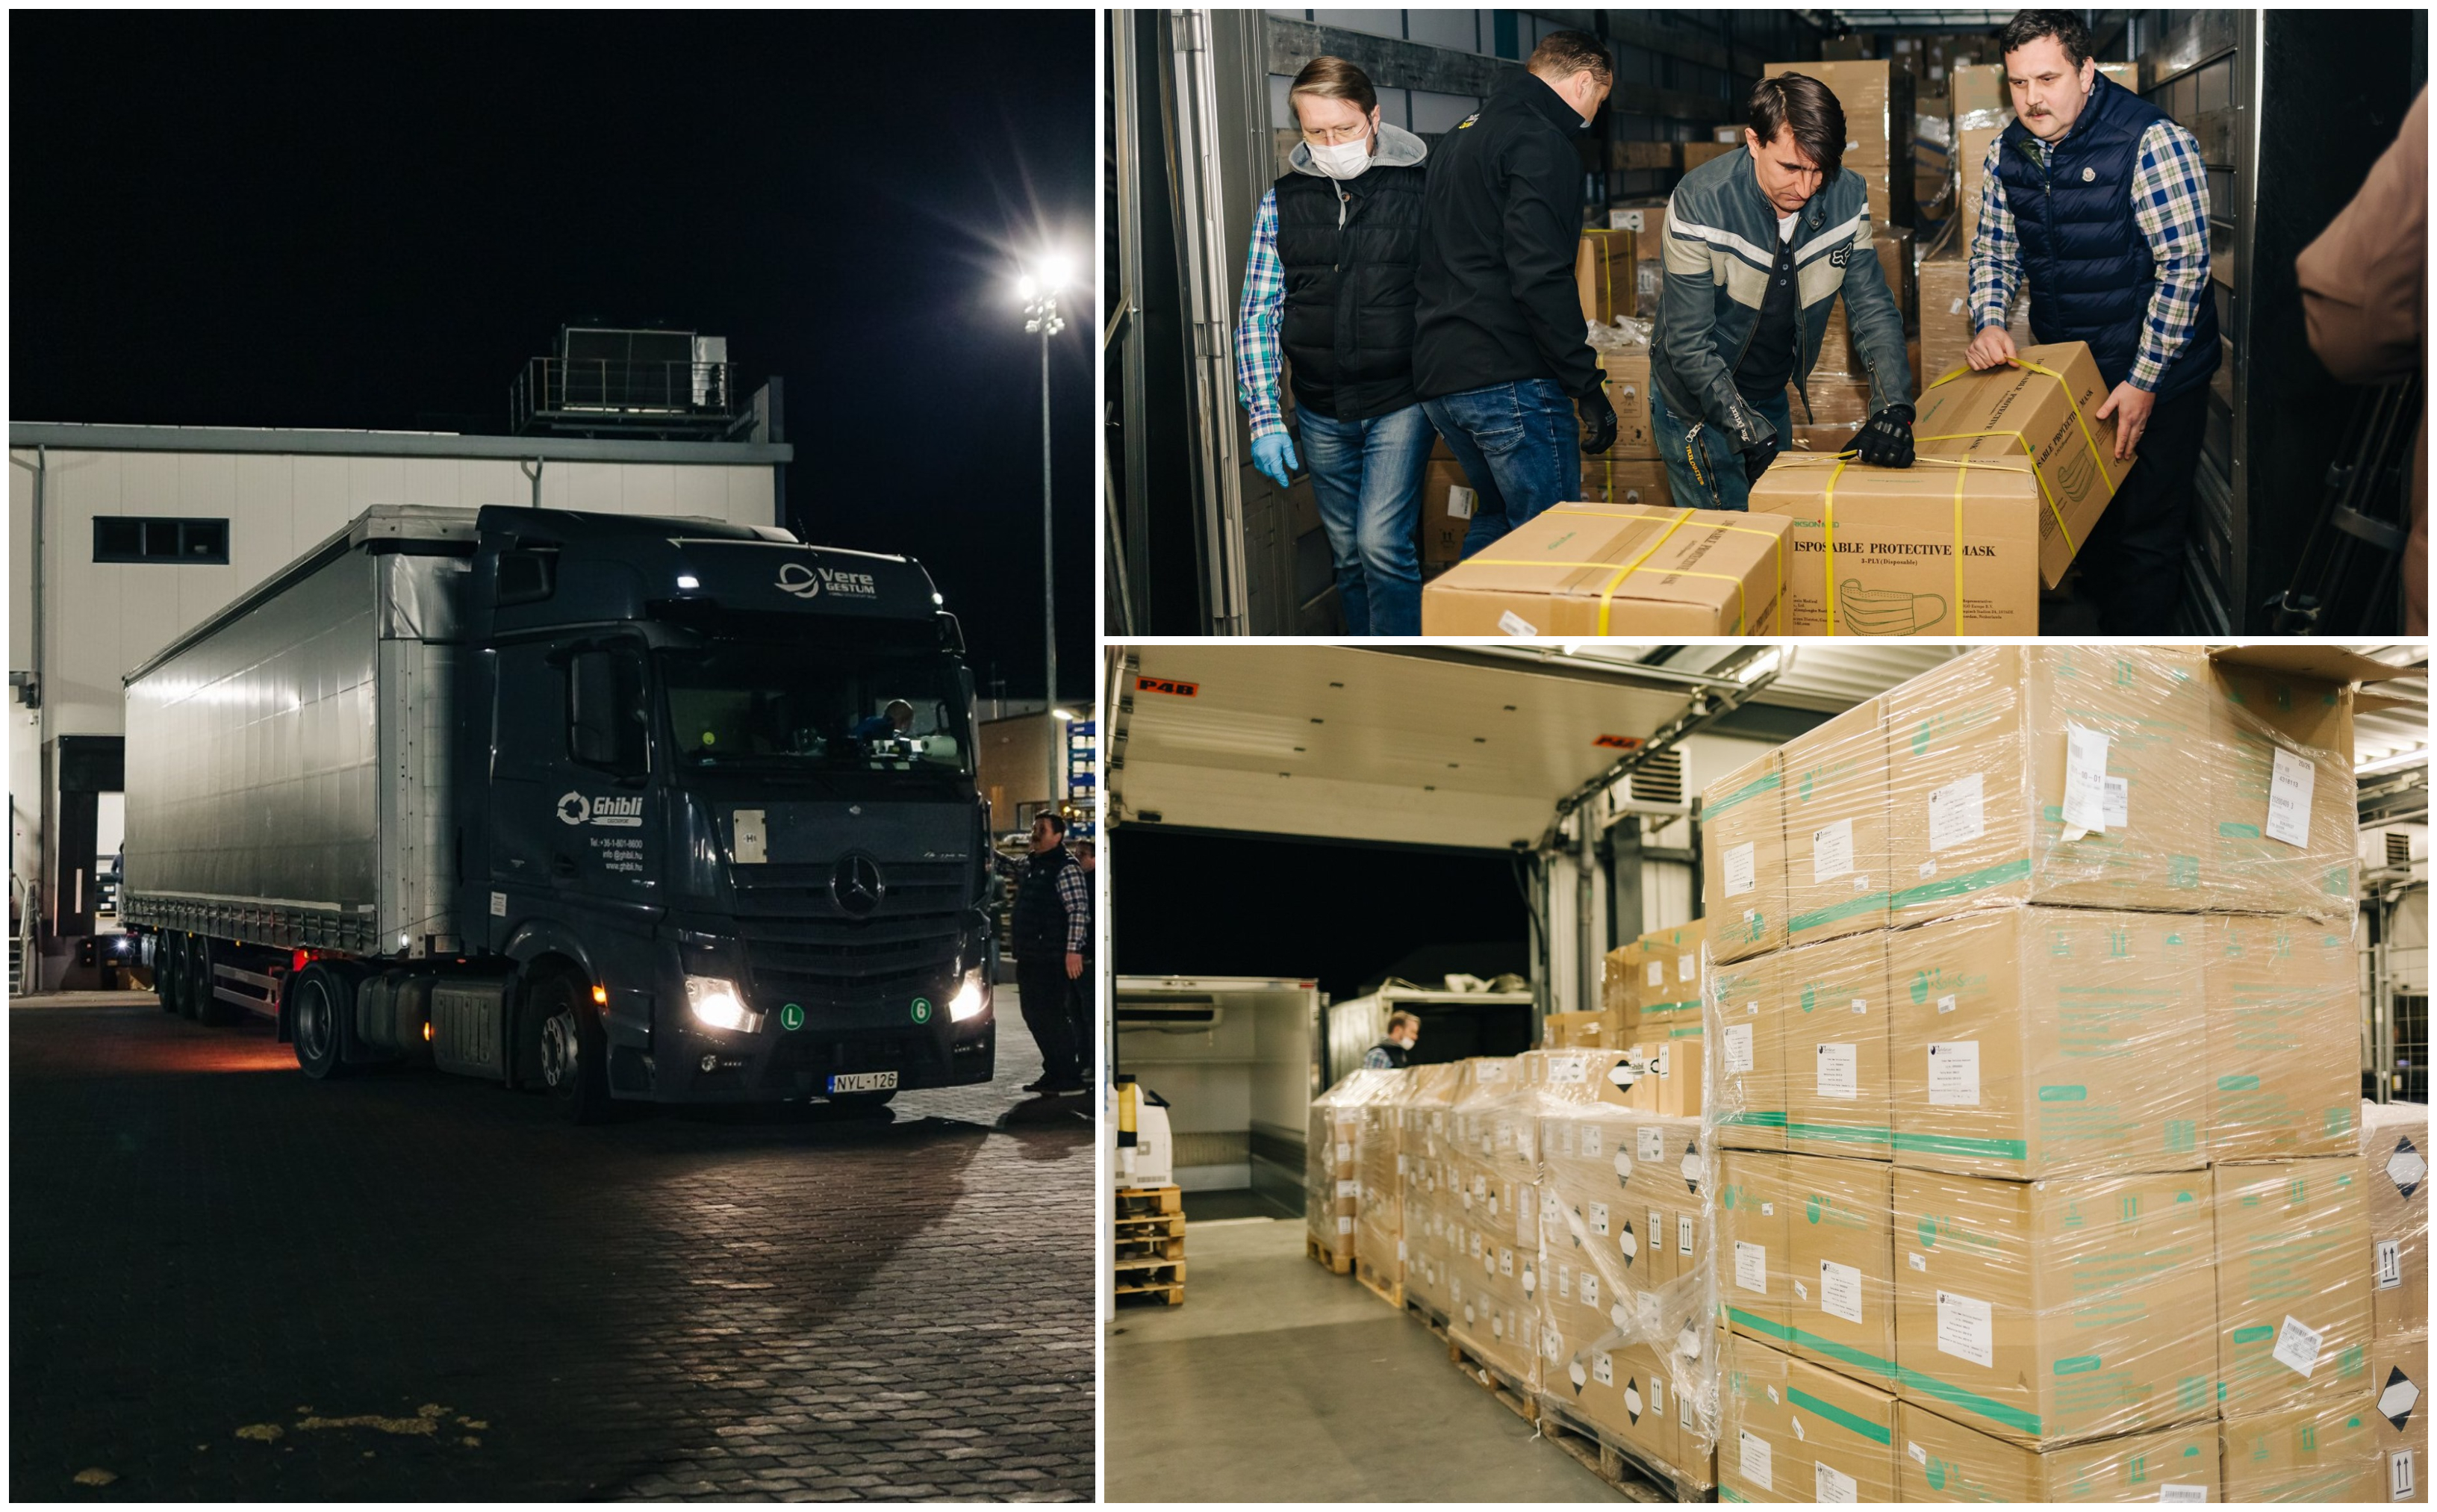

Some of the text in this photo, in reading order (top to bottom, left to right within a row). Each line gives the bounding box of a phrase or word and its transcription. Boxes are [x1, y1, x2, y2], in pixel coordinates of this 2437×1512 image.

[1793, 541, 1864, 553] ISPOSABLE
[1870, 543, 1952, 556] PROTECTIVE
[817, 567, 874, 585] Vere
[825, 582, 876, 594] GESTUM
[1139, 679, 1194, 695] P4B
[593, 797, 643, 815] Ghibli
[788, 1009, 798, 1025] L
[916, 1002, 926, 1019] 6
[835, 1073, 896, 1091] NYL-126
